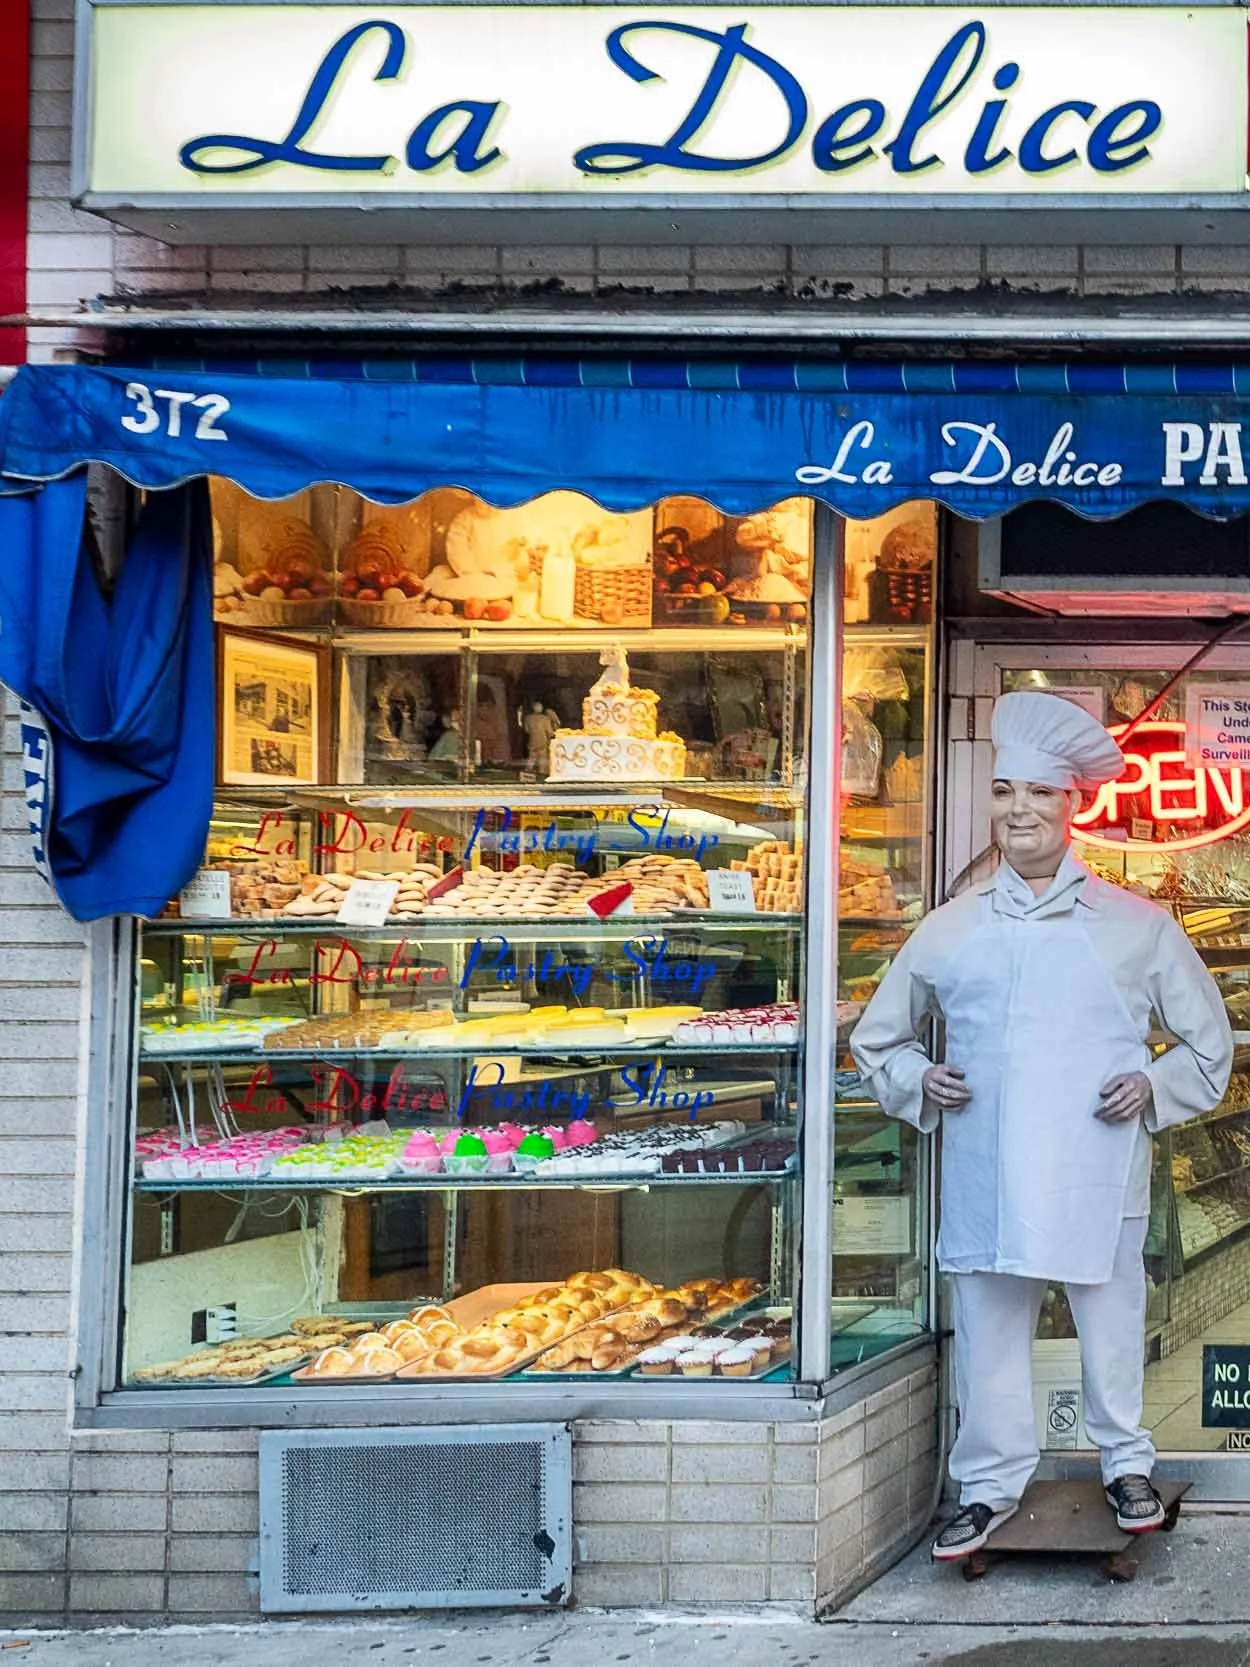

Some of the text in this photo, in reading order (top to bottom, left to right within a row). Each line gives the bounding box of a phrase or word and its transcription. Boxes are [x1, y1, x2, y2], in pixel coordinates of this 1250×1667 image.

[180, 20, 505, 174] La
[574, 20, 1164, 175] Delice
[796, 421, 893, 485] La
[929, 421, 1123, 486] Delice
[1202, 700, 1230, 712] This
[230, 803, 720, 863] La Delice Pastry Shop
[223, 934, 717, 995] La Delice Pastry Shop
[219, 1060, 715, 1121] La Delice Pastry Shop
[1214, 1363, 1240, 1383] NO
